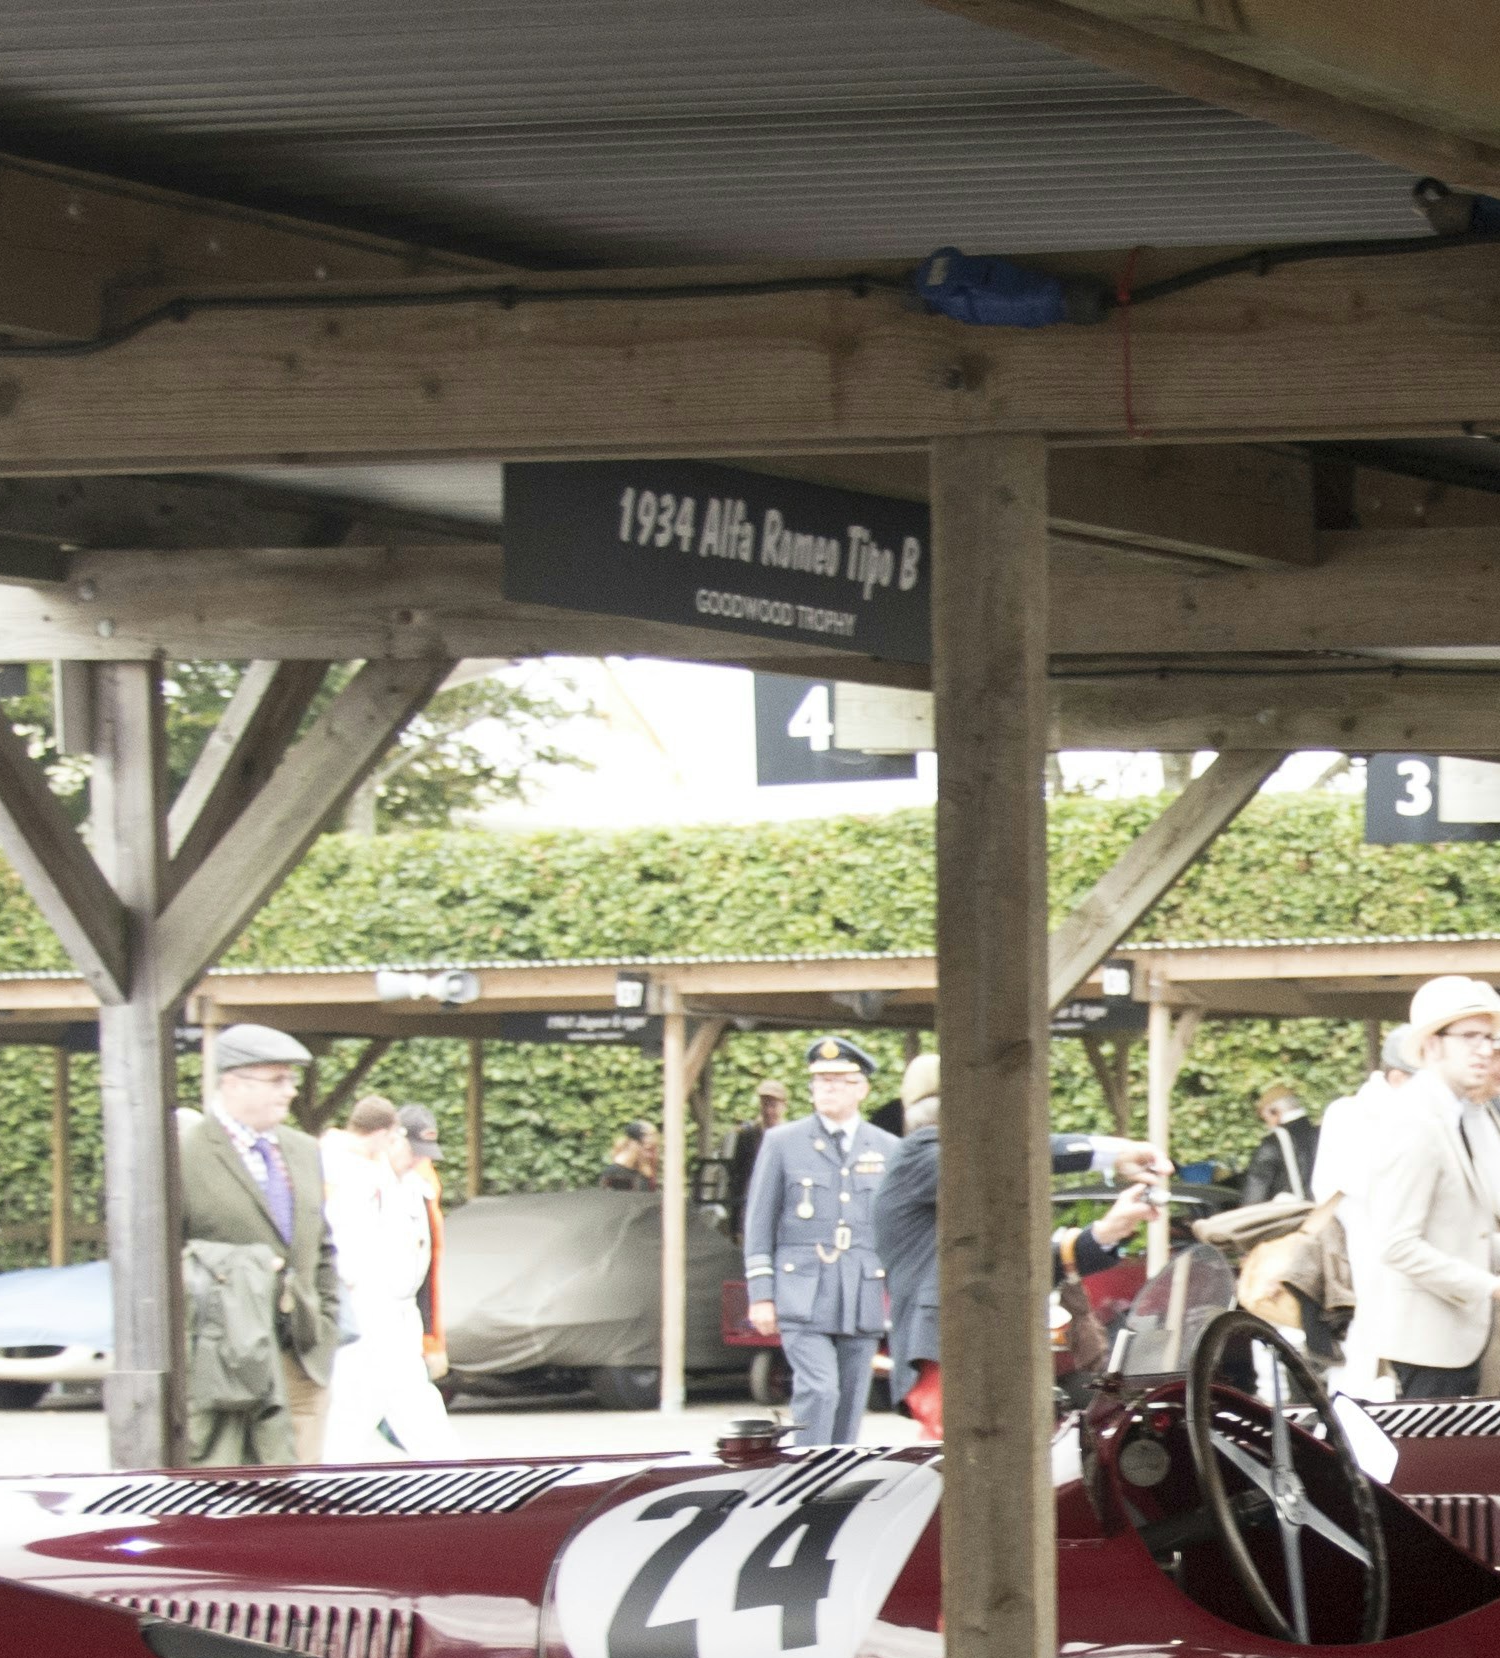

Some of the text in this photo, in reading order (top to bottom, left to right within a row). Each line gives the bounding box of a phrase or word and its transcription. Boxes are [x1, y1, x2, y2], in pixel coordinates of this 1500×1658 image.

[617, 485, 921, 601] 1934 Alfa Romeo Tipo B
[694, 588, 857, 640] GOODWOOD TROPHY
[788, 683, 834, 752] 4
[1396, 759, 1435, 818] 3
